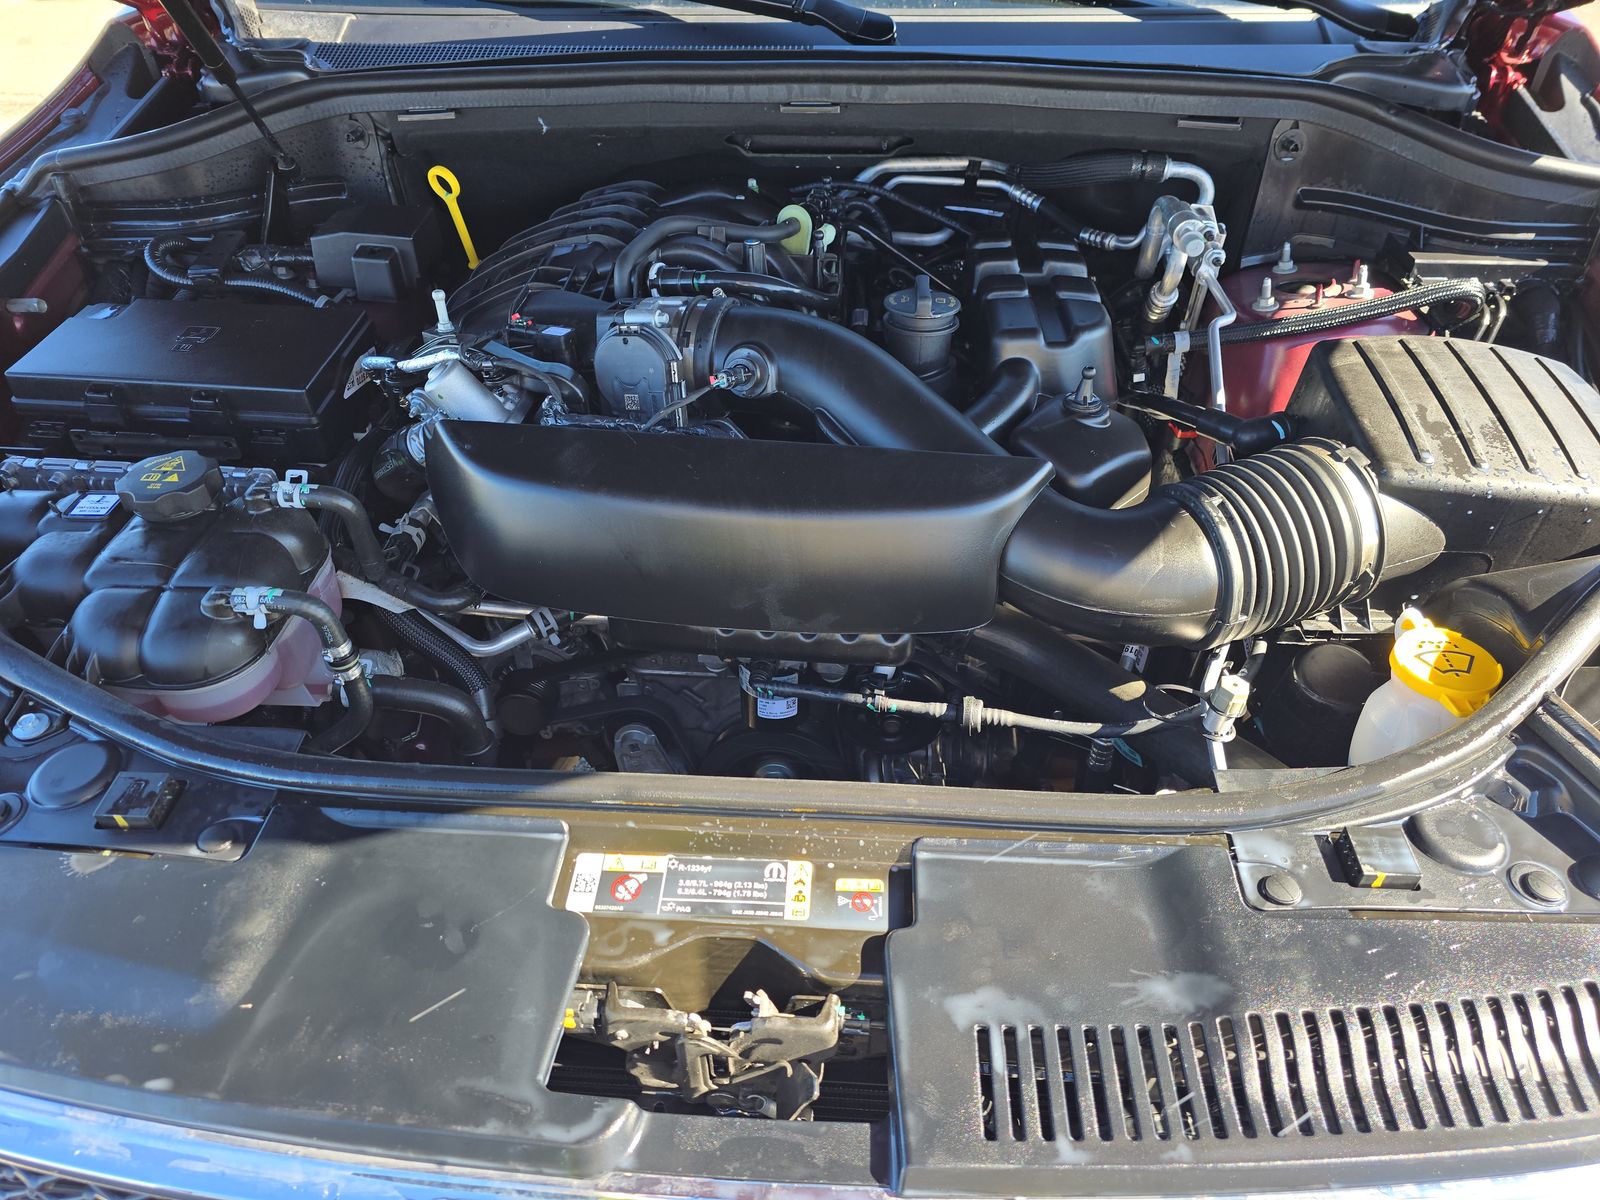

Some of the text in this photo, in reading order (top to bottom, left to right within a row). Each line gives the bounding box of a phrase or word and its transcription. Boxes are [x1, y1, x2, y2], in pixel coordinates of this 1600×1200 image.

[678, 864, 712, 874] R-1234yf
[753, 882, 768, 890] lbs)
[752, 891, 767, 899] lbs)
[675, 905, 692, 913] PAG
